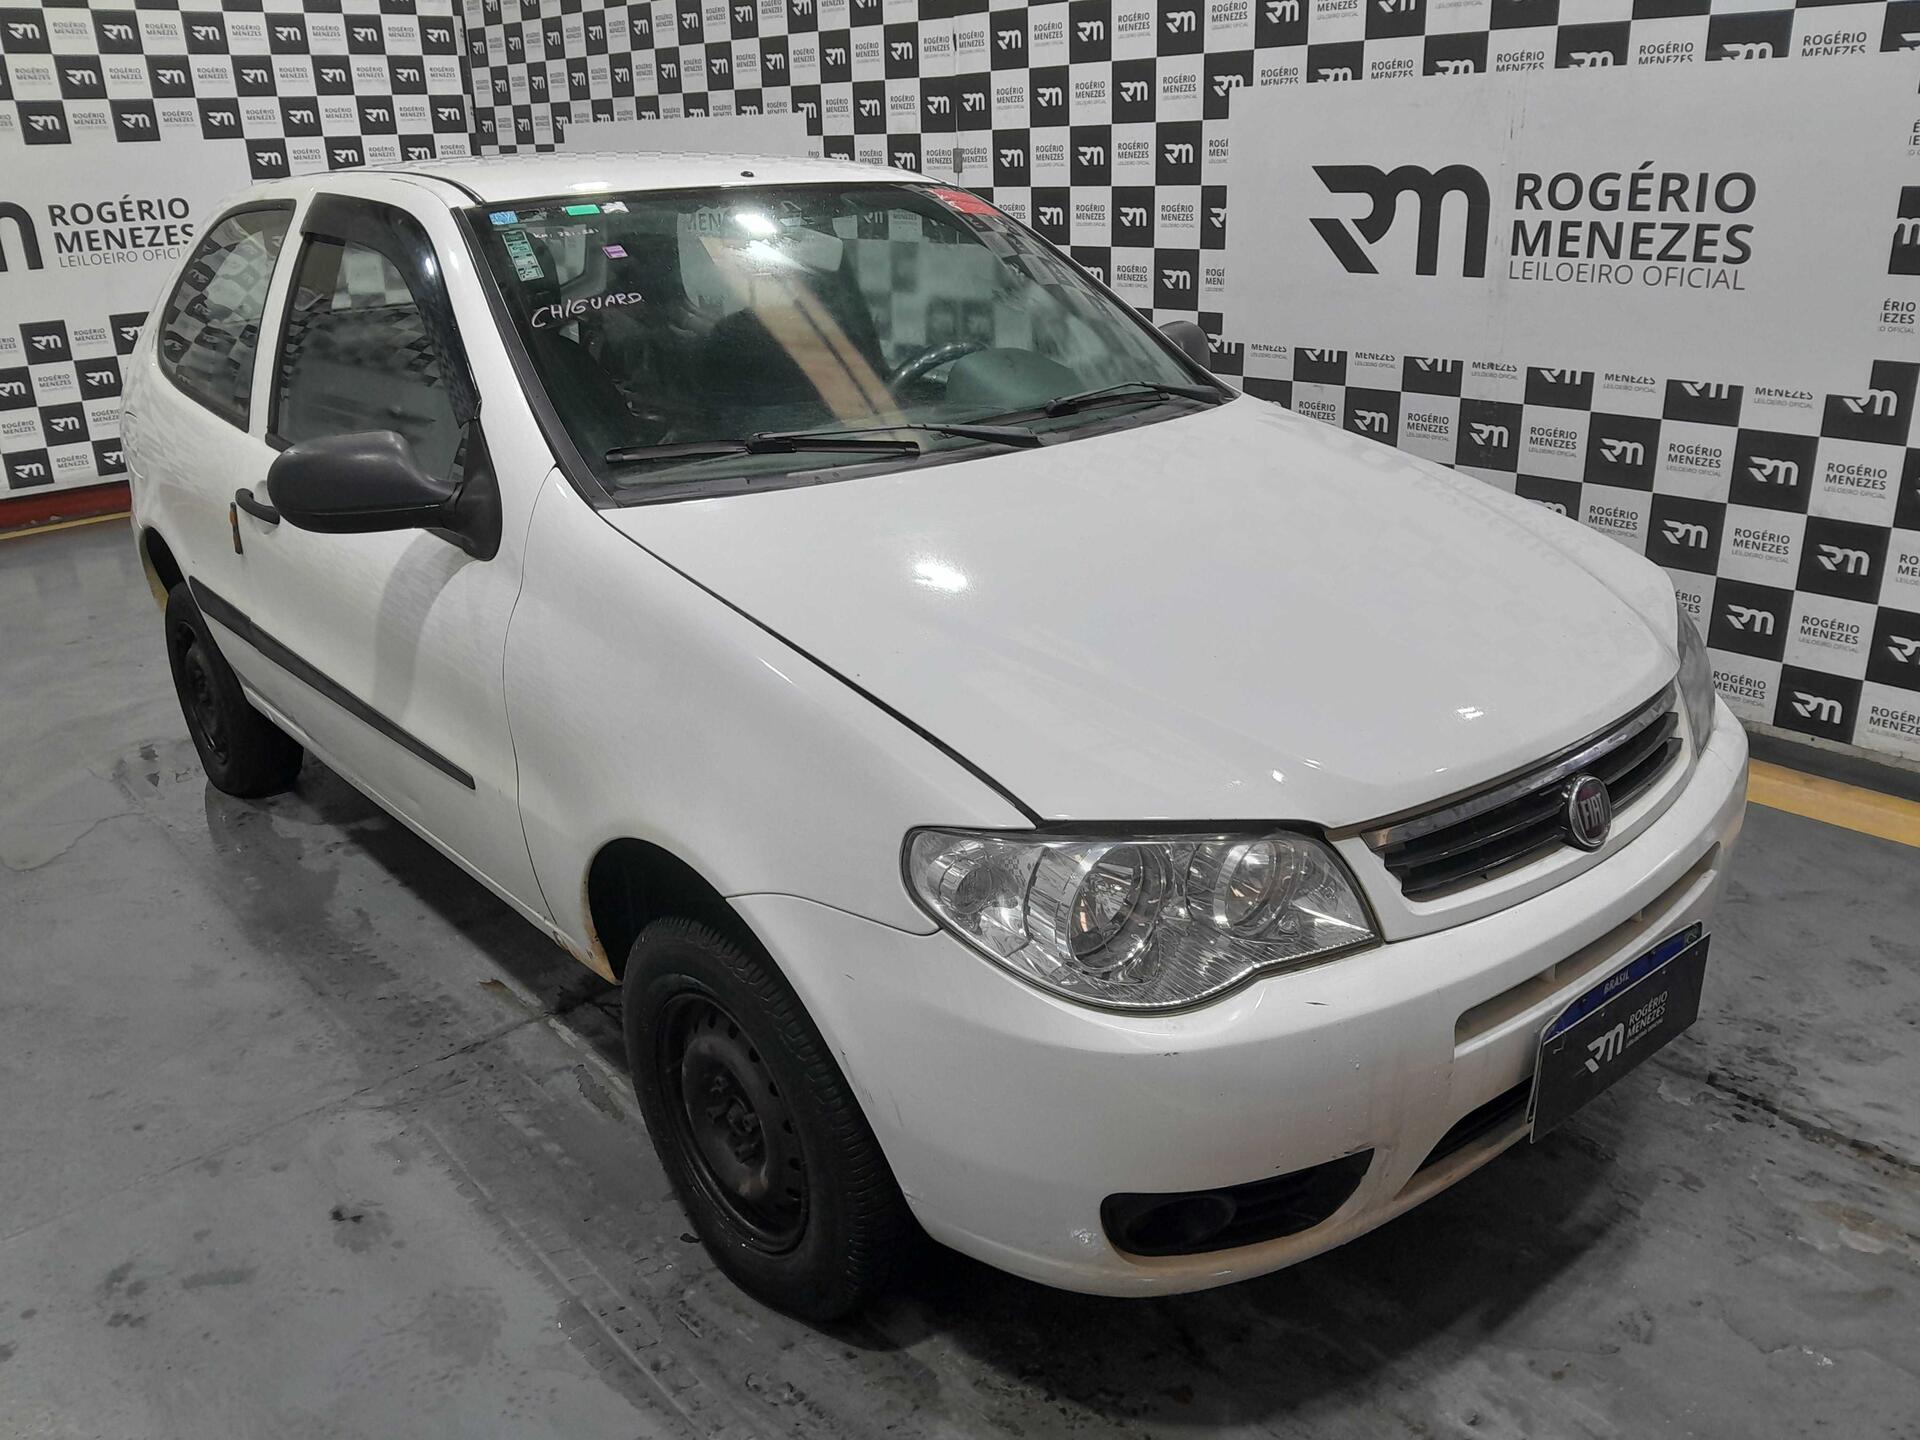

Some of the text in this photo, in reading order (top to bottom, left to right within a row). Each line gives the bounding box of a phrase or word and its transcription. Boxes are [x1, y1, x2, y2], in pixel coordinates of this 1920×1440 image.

[1212, 2, 1248, 11] ROGÉRIO
[1118, 12, 1150, 22] ROGÉRIO
[1212, 12, 1248, 22] MENEZES
[1034, 22, 1062, 31] ROGÉRIO
[1118, 21, 1150, 32] MENEZES
[959, 30, 984, 38] ROGÉRIO
[1034, 31, 1063, 40] MENEZES
[1803, 31, 1867, 46] ROGÉRIO
[923, 36, 950, 44] ROGÉRIO
[959, 39, 985, 48] MENEZES
[1639, 42, 1694, 55] ROGÉRIO
[1496, 50, 1545, 63] ROGÉRIO
[1371, 60, 1413, 71] ROGÉRIO
[1163, 73, 1196, 83] ROGÉRIO
[1261, 68, 1298, 77] ROGÉRIO
[1076, 80, 1105, 89] ROGÉRIO
[1163, 83, 1196, 94] MENEZES
[996, 95, 1024, 104] MENEZES
[1076, 89, 1106, 99] MENEZES
[1036, 144, 1064, 154] ROGÉRIO
[1118, 142, 1149, 152] ROGÉRIO
[926, 150, 951, 158] ROGÉRIO
[1036, 152, 1064, 161] MENEZES
[1118, 150, 1149, 160] MENEZES
[927, 156, 952, 164] MENEZES
[962, 156, 988, 164] MENEZES
[1515, 160, 1756, 214] ROGÉRIO
[47, 194, 190, 227] ROGÉRIO
[1076, 204, 1105, 213] ROGÉRIO
[1161, 204, 1193, 213] ROGÉRIO
[1076, 212, 1106, 220] MENEZES
[1161, 212, 1193, 221] MENEZES
[54, 223, 194, 254] MENEZES
[1511, 220, 1754, 264] MENEZES
[59, 247, 181, 268] LEILOEIRO OFICI
[1117, 264, 1147, 274] ROGÉRIO
[1117, 272, 1148, 282] MENEZES
[1509, 260, 1745, 291] LEILOEIRO OFICIAL
[1299, 401, 1336, 412] ROGÉRIO
[1408, 413, 1449, 425] ROGÉRIO
[1407, 422, 1449, 434] MENEZES
[1530, 426, 1577, 440] ROGÉRIO
[1529, 436, 1577, 449] MENEZES
[1669, 443, 1722, 458] ROGÉRIO
[1668, 453, 1721, 468] MENEZES
[1827, 462, 1887, 479] ROGÉRIO
[1825, 473, 1886, 490] MENEZES
[1590, 505, 1638, 521] ROGÉRIO
[1588, 516, 1638, 530] MENEZES
[1734, 528, 1790, 544] ROGÉRIO
[1733, 538, 1789, 555] MENEZES
[1802, 616, 1860, 633] ROGÉRIO
[1800, 626, 1858, 644] MENEZES
[1713, 671, 1766, 689] ROGÉRIO
[1713, 681, 1765, 699] MENEZES
[1871, 705, 1920, 724] ROGÉRI
[1869, 716, 1920, 736] MENEZE
[1604, 970, 1630, 994] BRASIL
[1629, 991, 1669, 1026] ROGÉRIO
[1626, 1003, 1666, 1039] MENEZES
